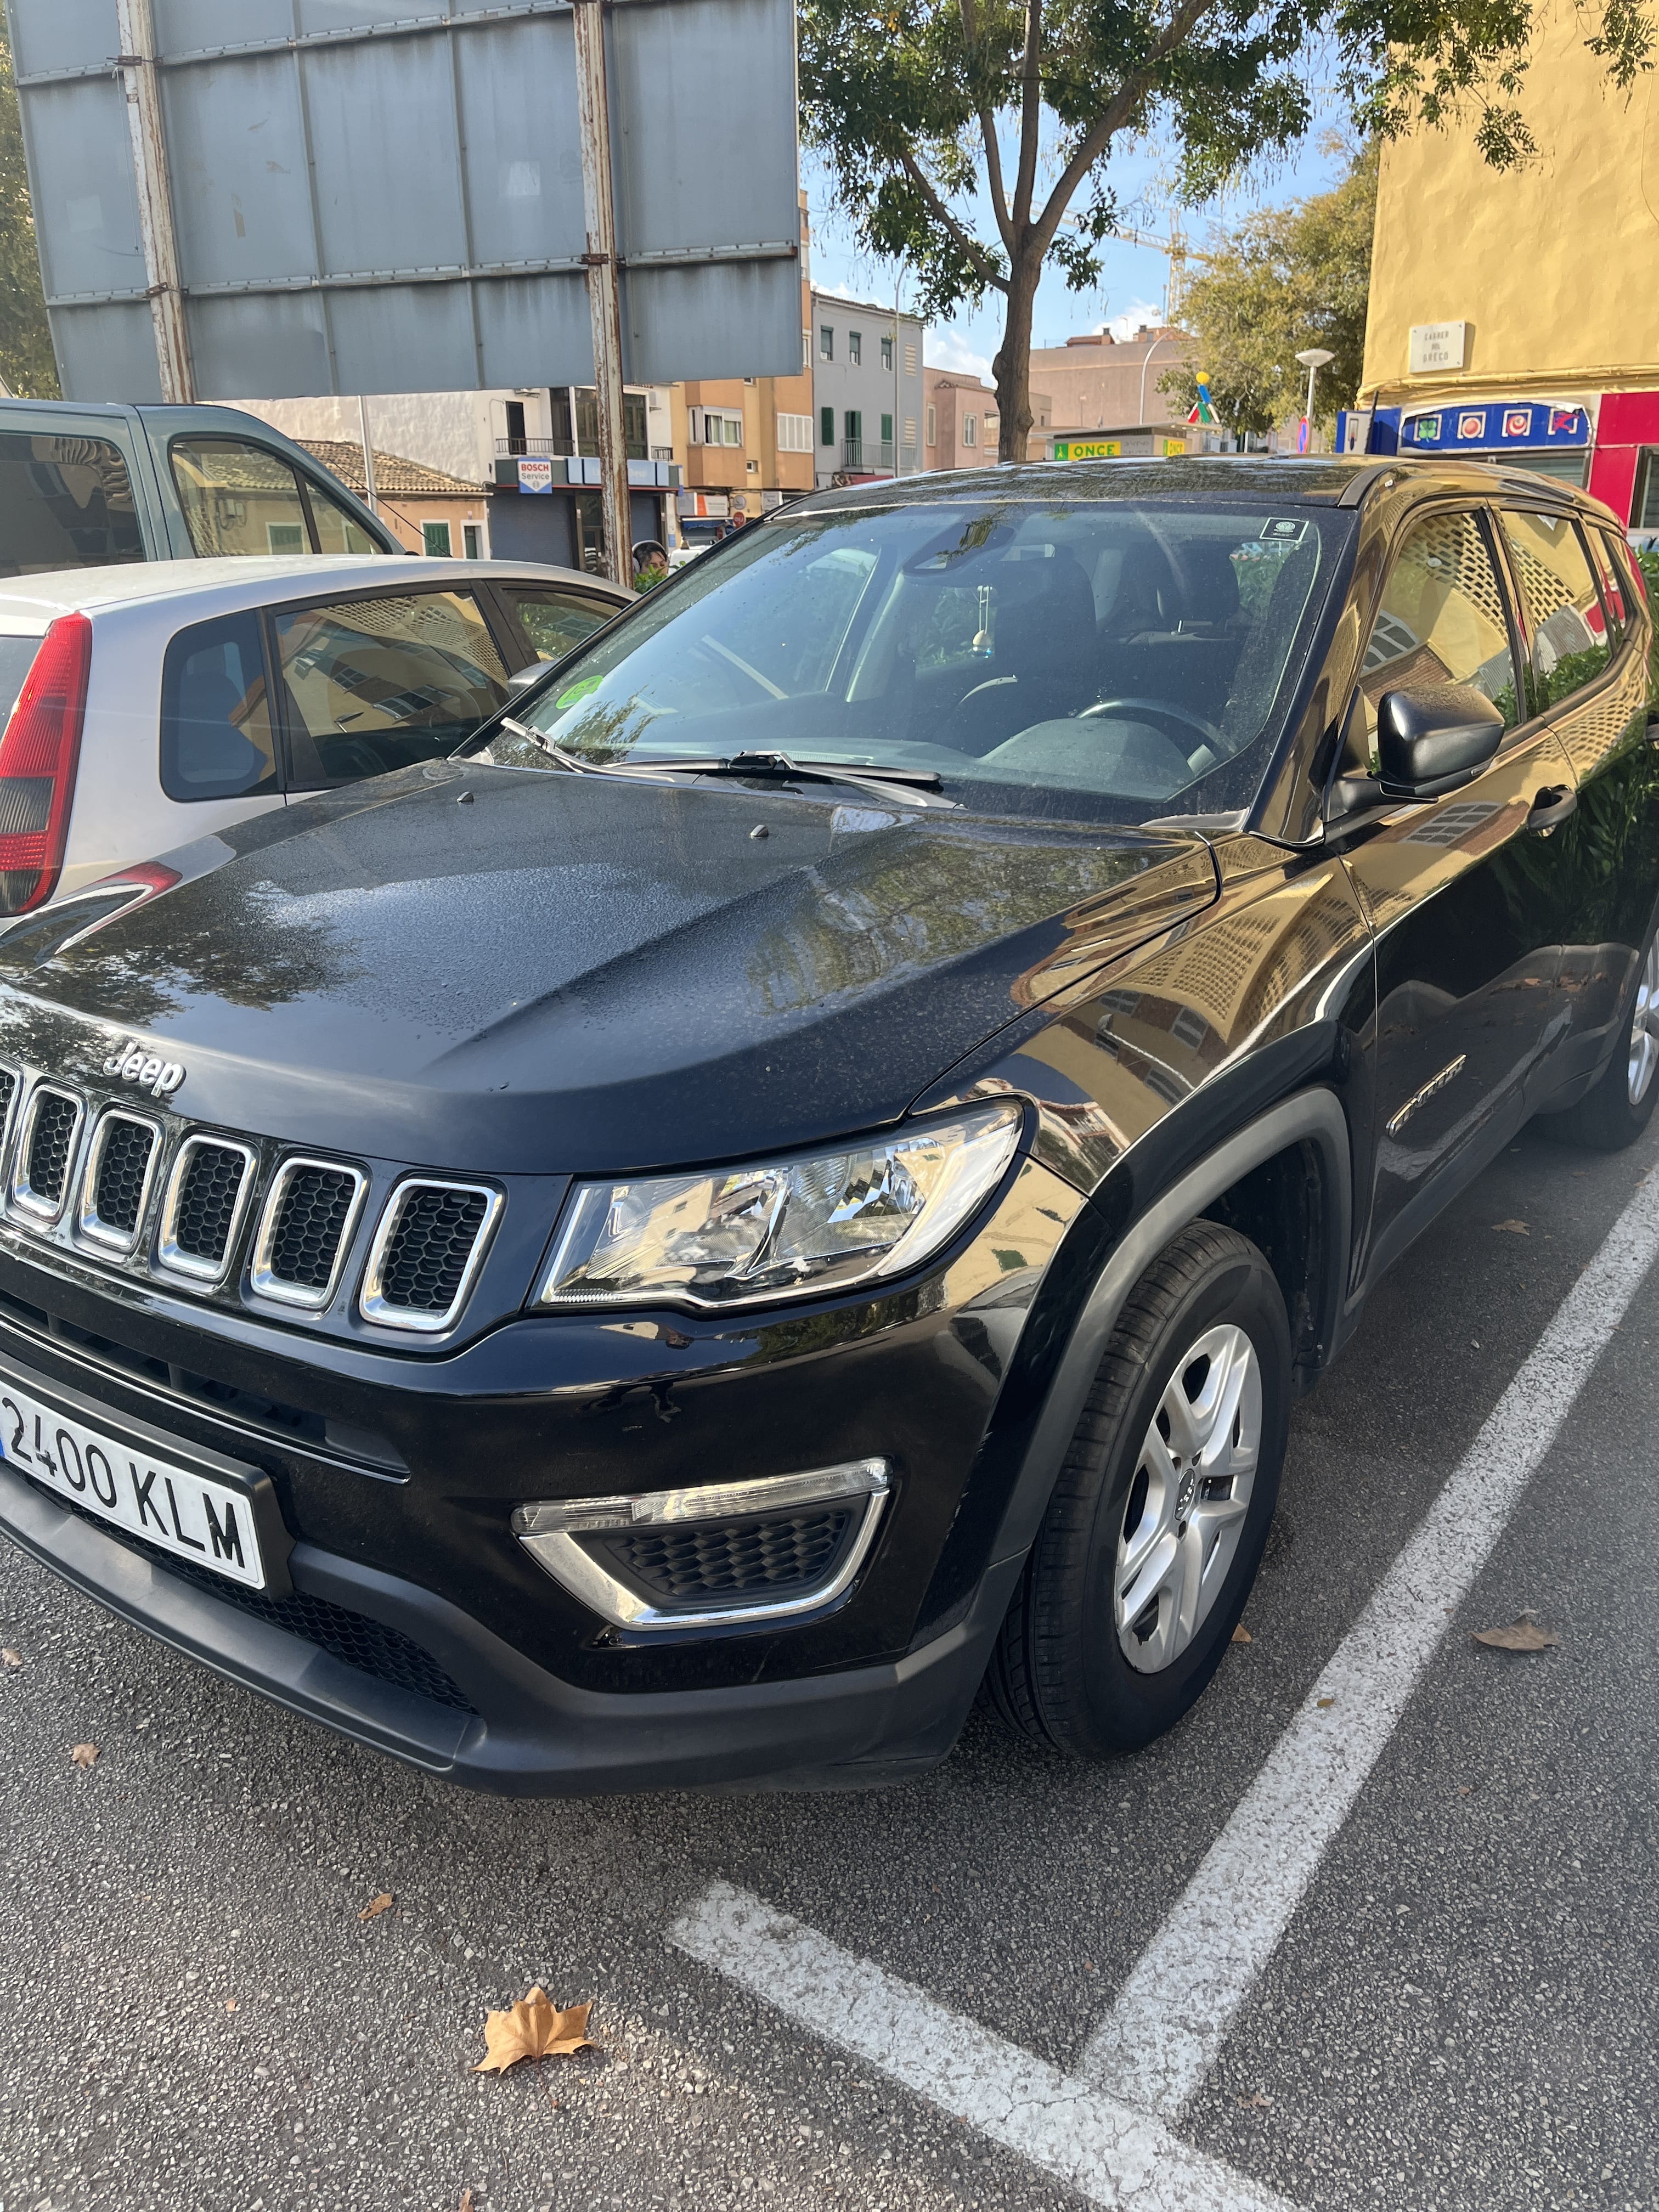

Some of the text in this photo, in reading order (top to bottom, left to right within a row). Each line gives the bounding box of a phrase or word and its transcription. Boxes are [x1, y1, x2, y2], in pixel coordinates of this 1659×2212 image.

[1074, 444, 1115, 457] ONCE
[103, 1041, 187, 1098] Jeep
[2, 1397, 245, 1569] 2400 KLM
